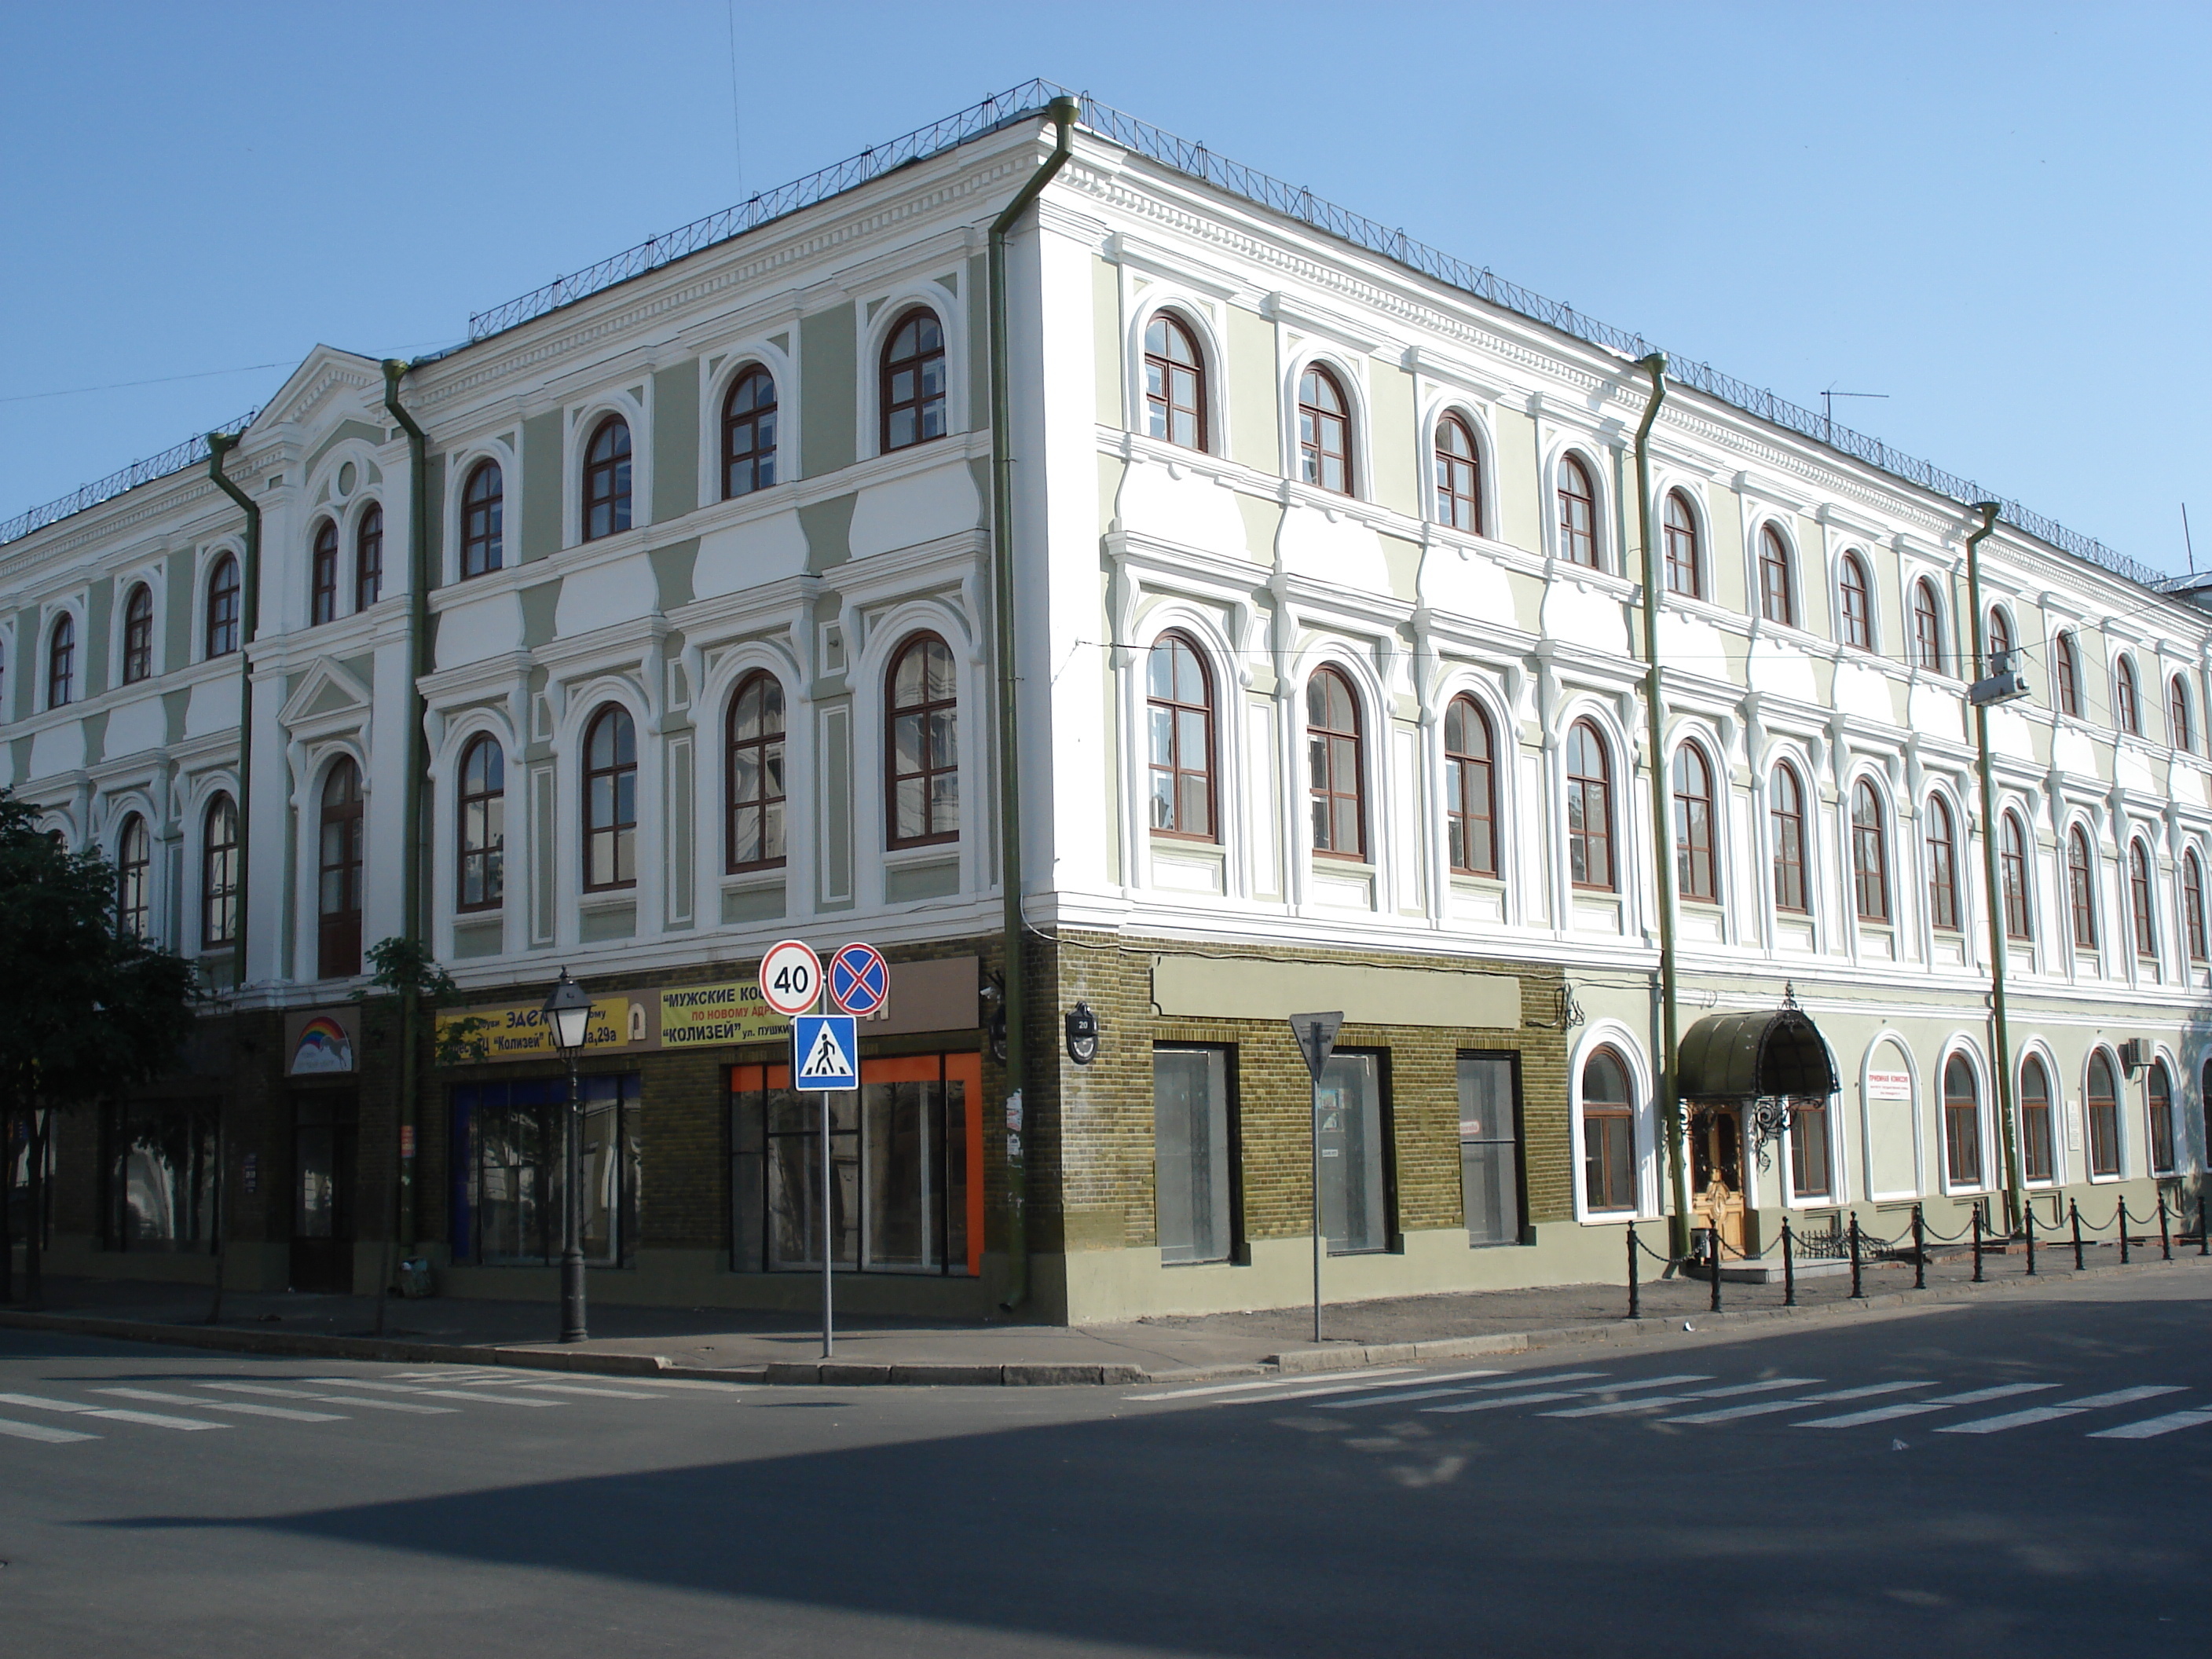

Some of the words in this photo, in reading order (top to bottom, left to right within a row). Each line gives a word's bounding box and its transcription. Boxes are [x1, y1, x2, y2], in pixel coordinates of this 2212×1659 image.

[774, 965, 809, 994] 40
[692, 1011, 705, 1021] ПО
[708, 1007, 749, 1020] НОВОМУ
[742, 1030, 755, 1039] ул.
[758, 1024, 789, 1036] ПУШКИ
